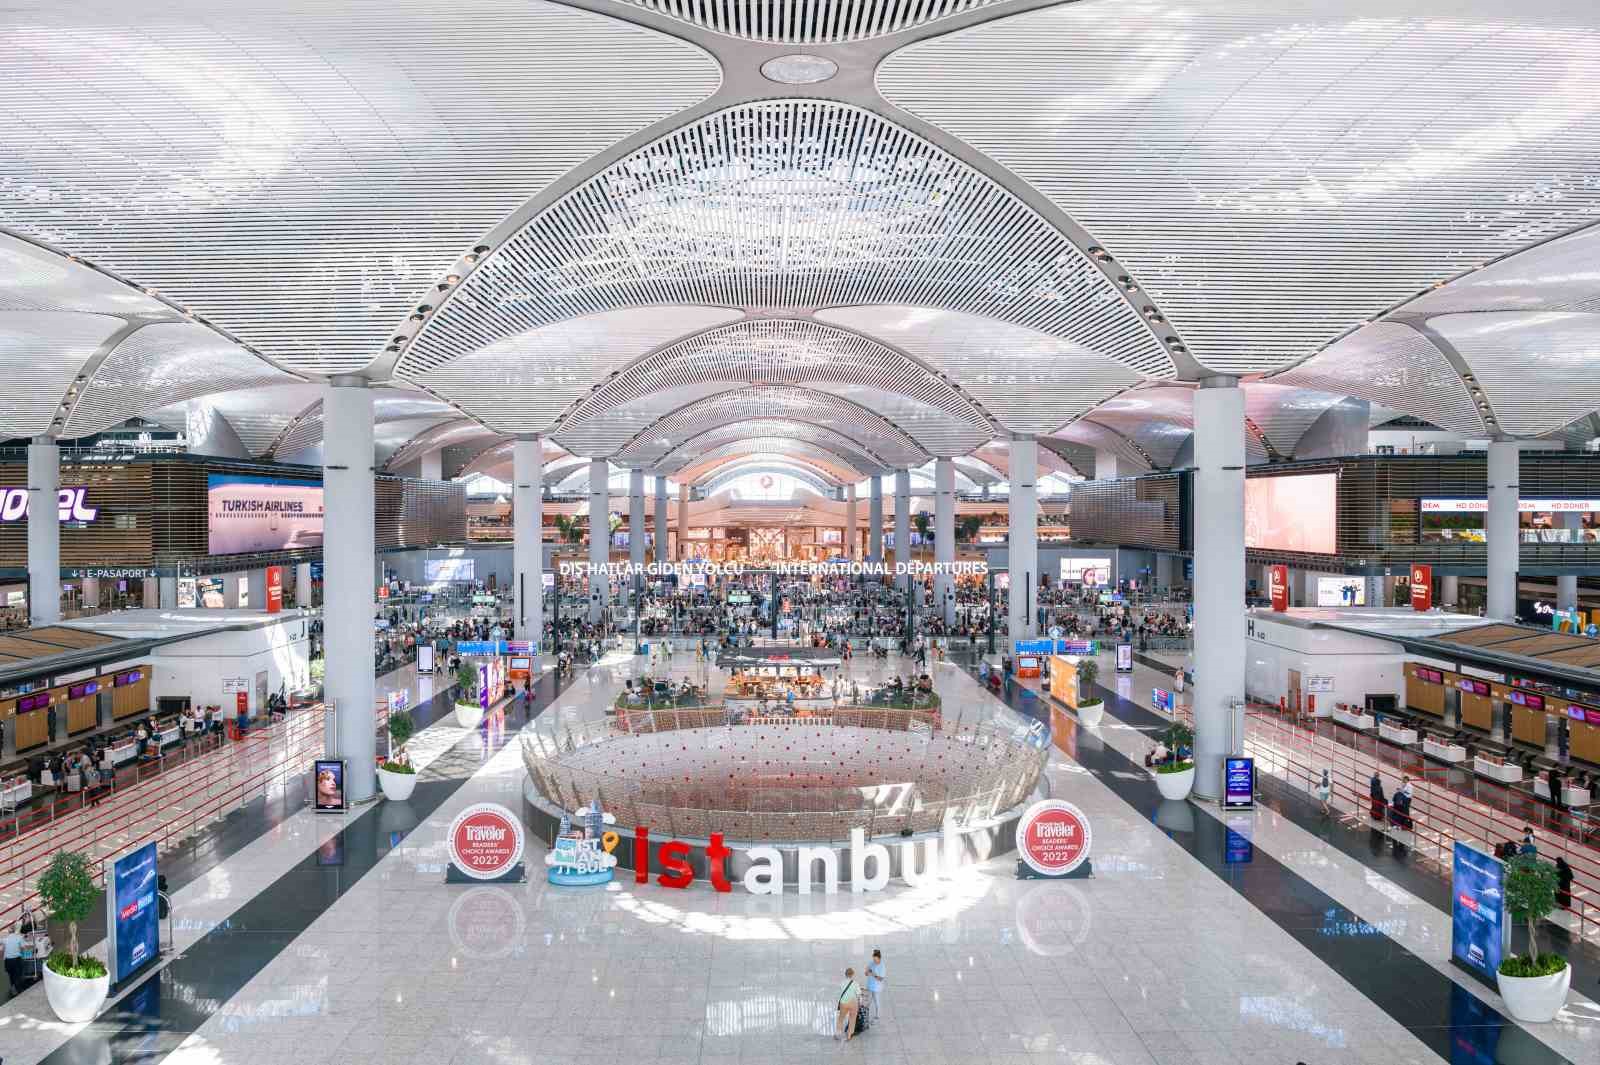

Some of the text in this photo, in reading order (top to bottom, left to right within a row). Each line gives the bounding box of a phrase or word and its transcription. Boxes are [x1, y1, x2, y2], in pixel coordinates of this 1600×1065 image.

[222, 500, 303, 512] TURKISH AIRLINES
[87, 569, 147, 578] E-PASAPORT
[587, 562, 643, 575] HATLAR
[647, 560, 692, 575] GİDEN
[695, 562, 744, 575] YOLCU
[776, 562, 988, 575] INTERNATIONAL DEPARTURES
[301, 620, 305, 638] J
[1248, 619, 1254, 637] H
[465, 826, 506, 841] Traveler
[1035, 822, 1076, 838] Traveler
[472, 856, 499, 865] 2022
[1043, 852, 1068, 861] 2022
